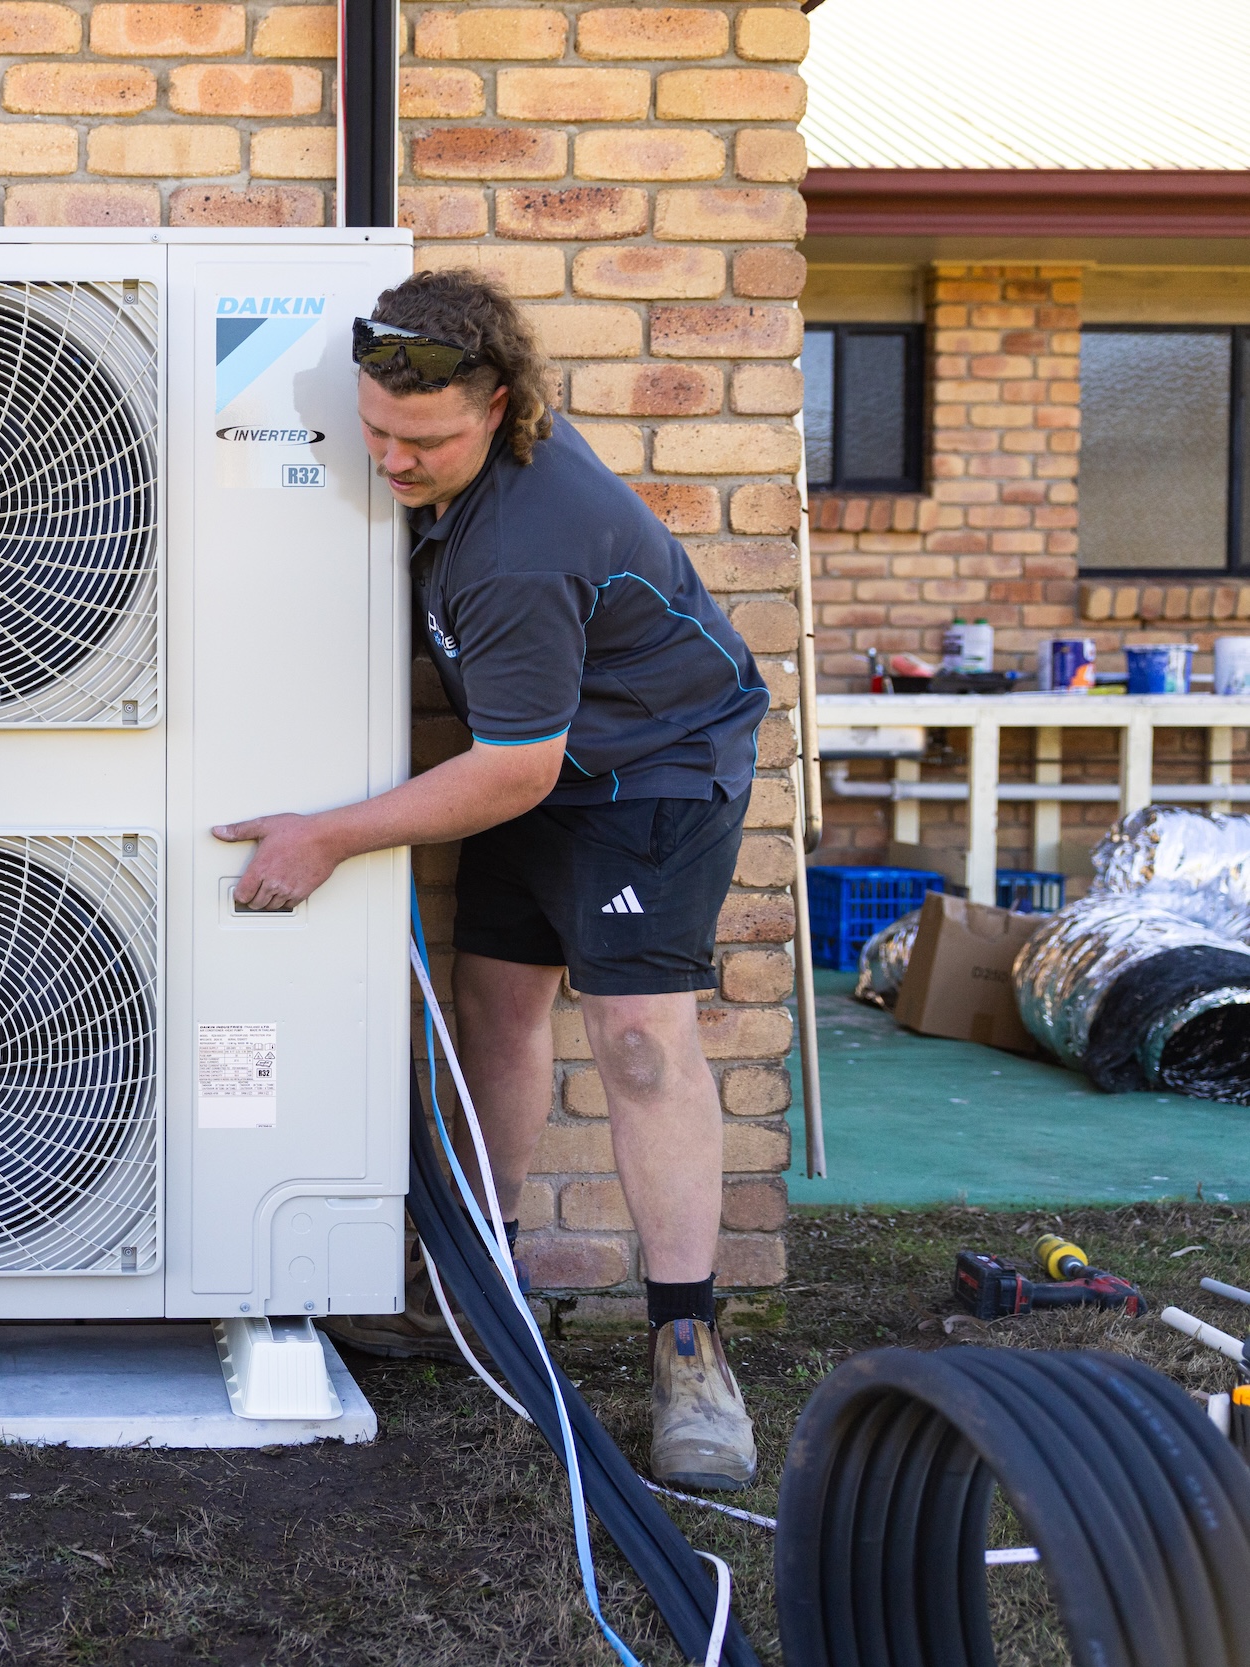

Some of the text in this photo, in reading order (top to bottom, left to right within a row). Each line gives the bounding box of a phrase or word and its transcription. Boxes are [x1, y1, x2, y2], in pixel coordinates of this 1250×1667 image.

[216, 297, 326, 315] DAIKIN
[234, 429, 308, 442] INVERTER
[288, 467, 320, 485] R32
[258, 1069, 270, 1077] R32
